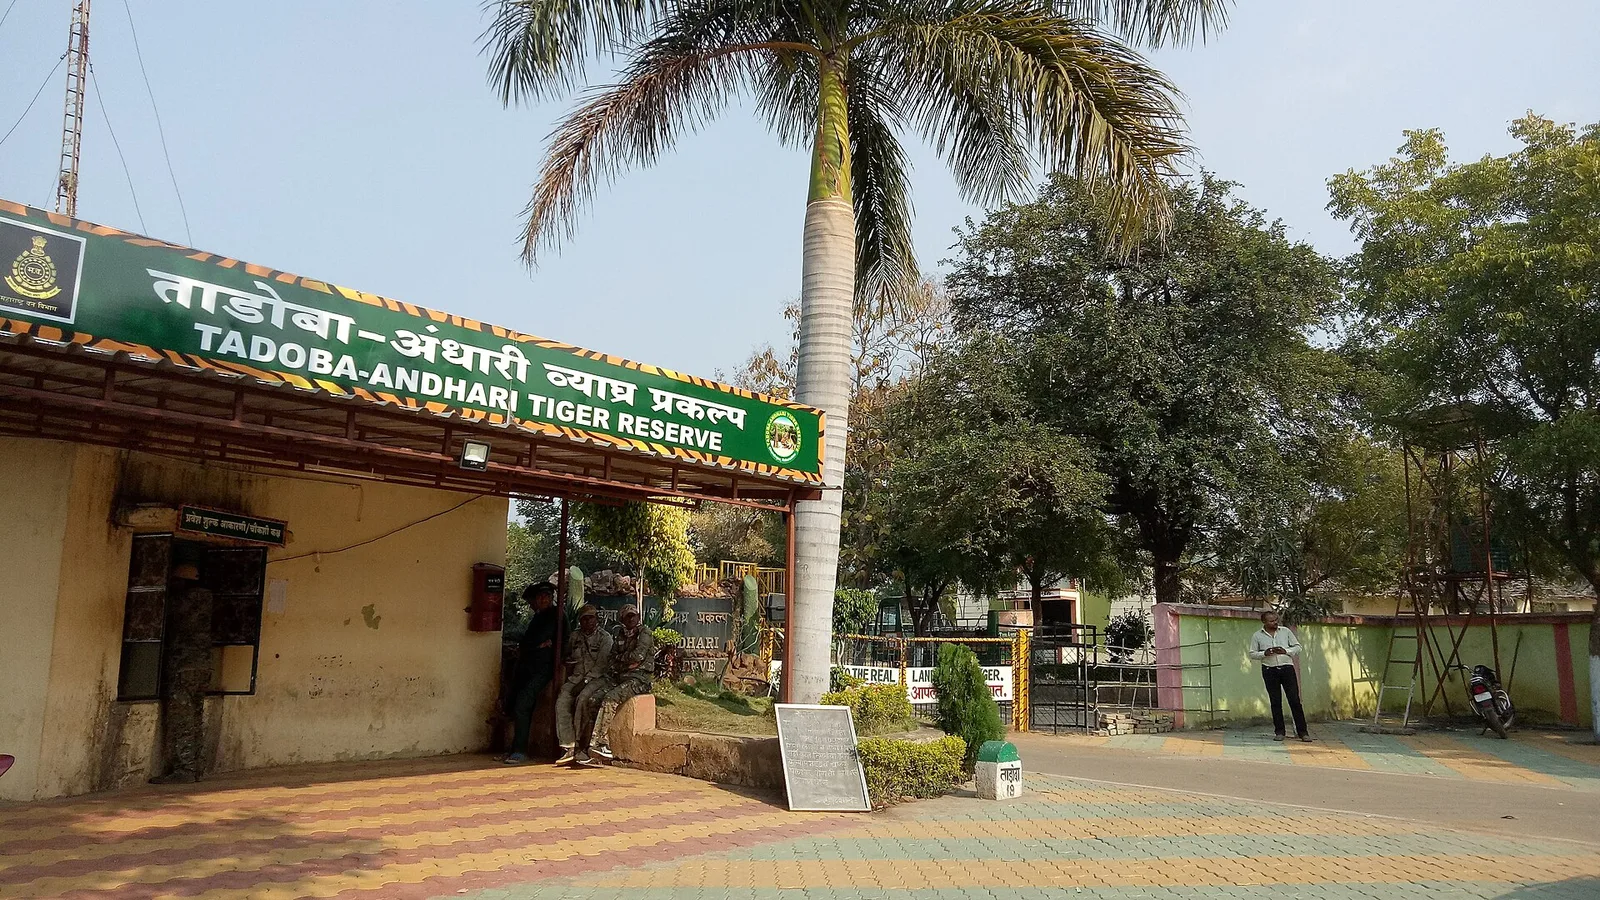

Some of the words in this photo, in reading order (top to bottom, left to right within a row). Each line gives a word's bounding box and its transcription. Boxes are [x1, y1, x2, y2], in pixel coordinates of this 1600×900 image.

[194, 322, 518, 412] TADOBA-ANDHARI
[527, 393, 611, 430] TIGER
[618, 413, 723, 452] RESERVE
[542, 362, 640, 408] व्याघ्र
[648, 387, 748, 431] प्रकल्प
[677, 637, 719, 649] DHARI
[852, 668, 868, 680] THE
[871, 669, 895, 682] REAL
